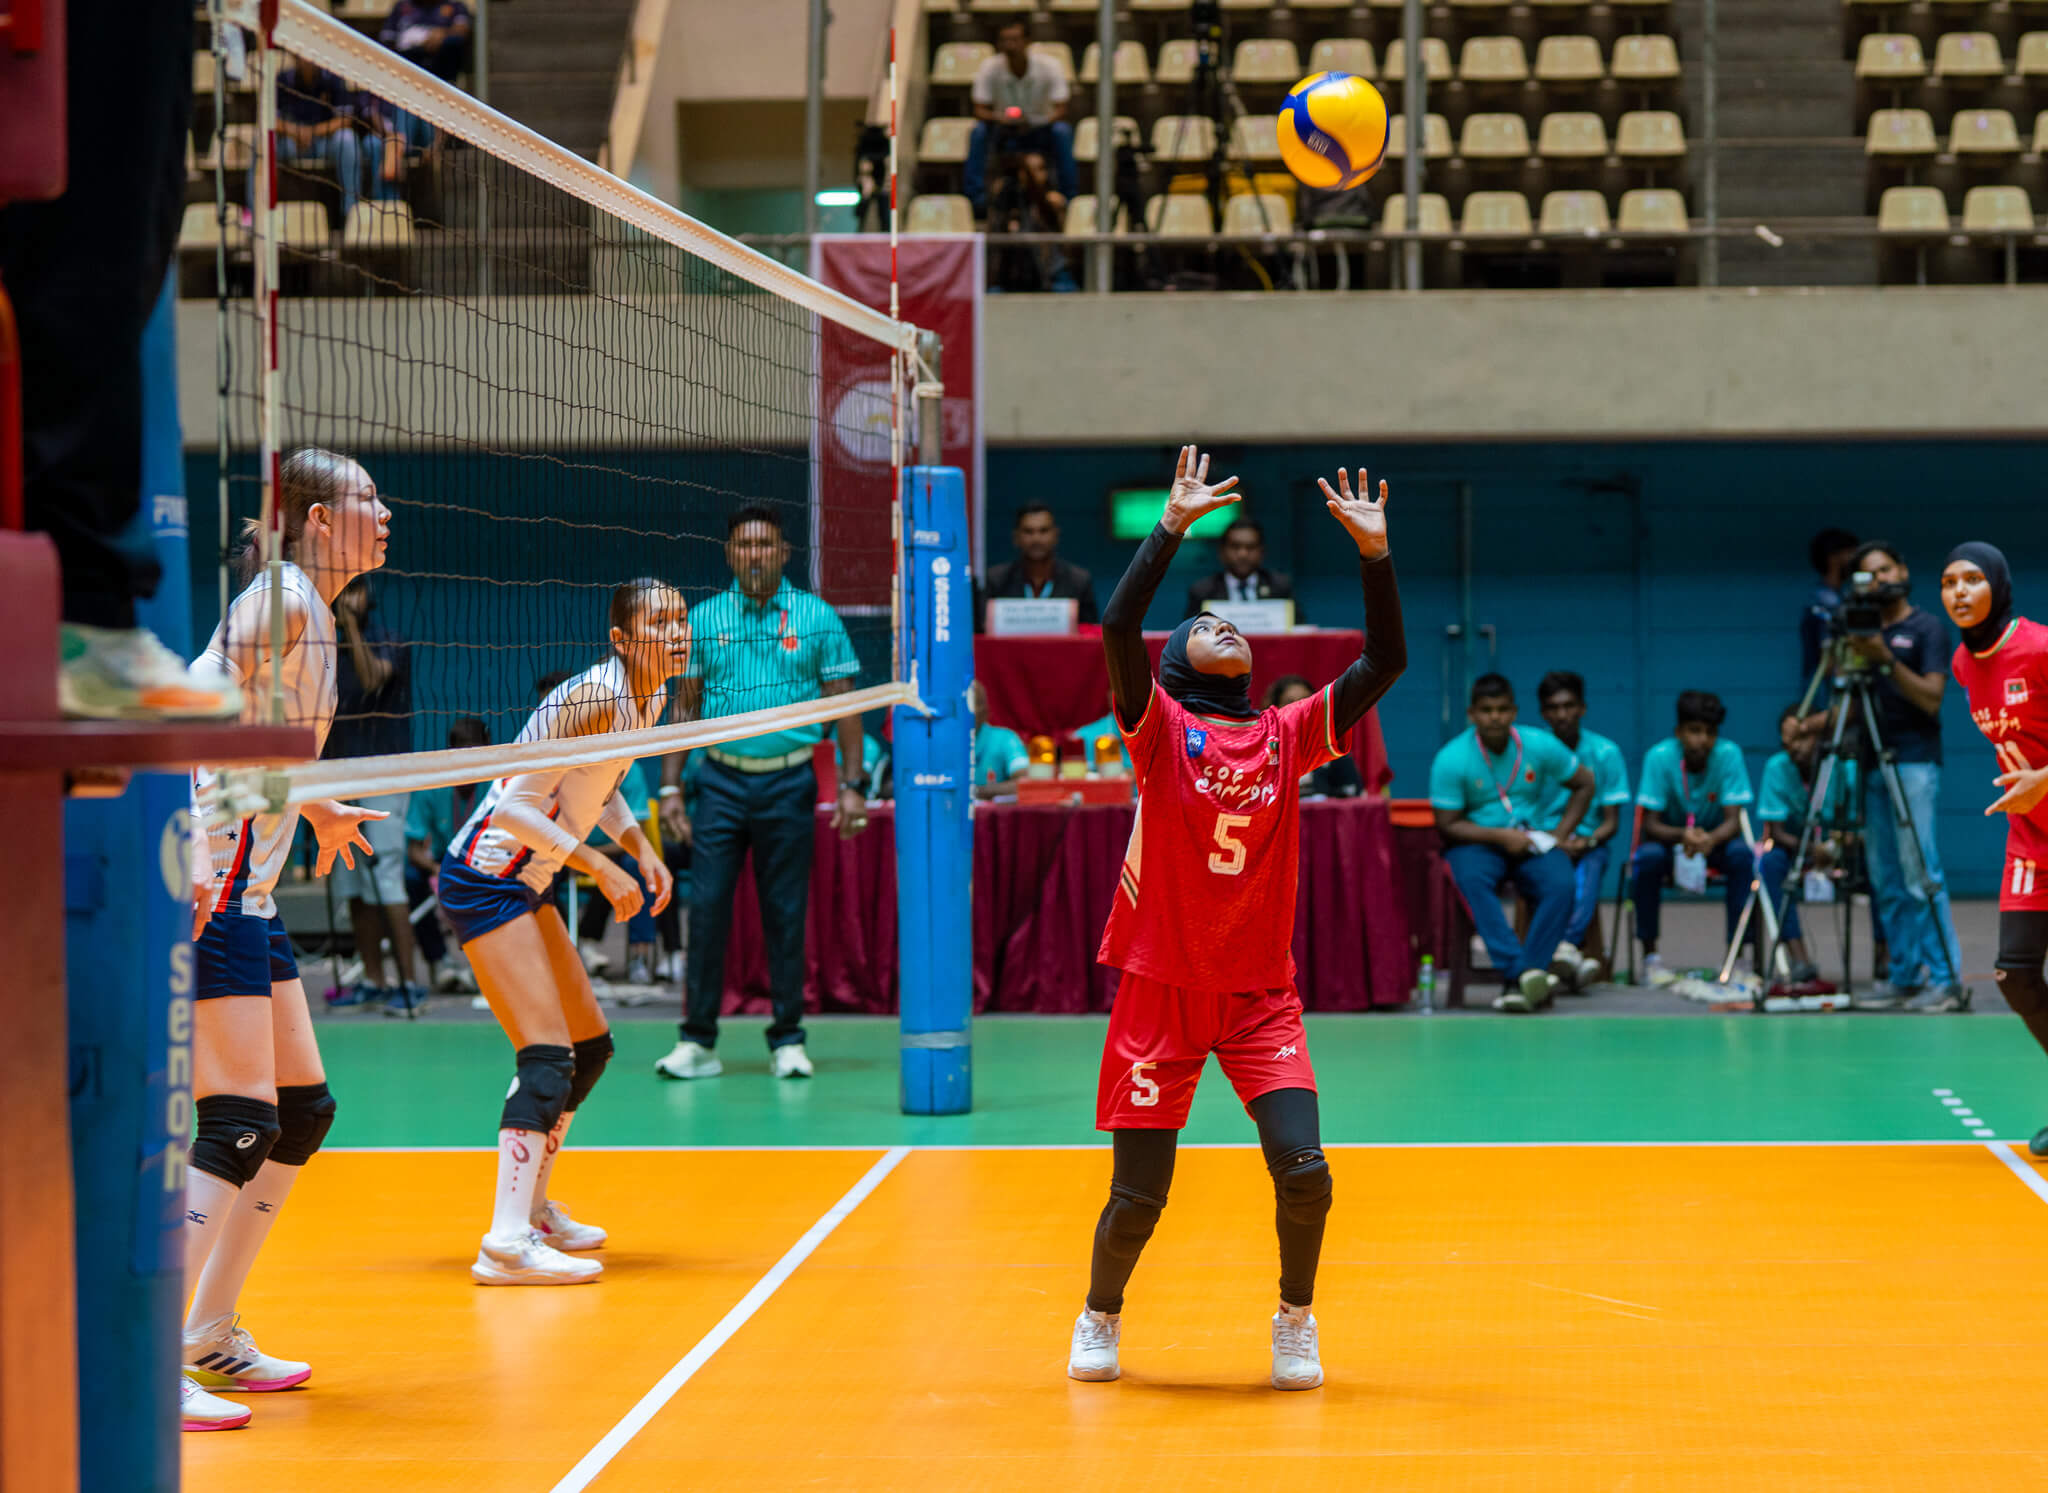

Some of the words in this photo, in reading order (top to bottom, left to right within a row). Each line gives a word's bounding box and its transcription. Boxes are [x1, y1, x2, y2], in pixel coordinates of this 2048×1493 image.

[1207, 812, 1252, 876] 5
[2011, 857, 2036, 895] 11
[165, 943, 191, 1190] senoh
[1131, 1061, 1159, 1107] 5
